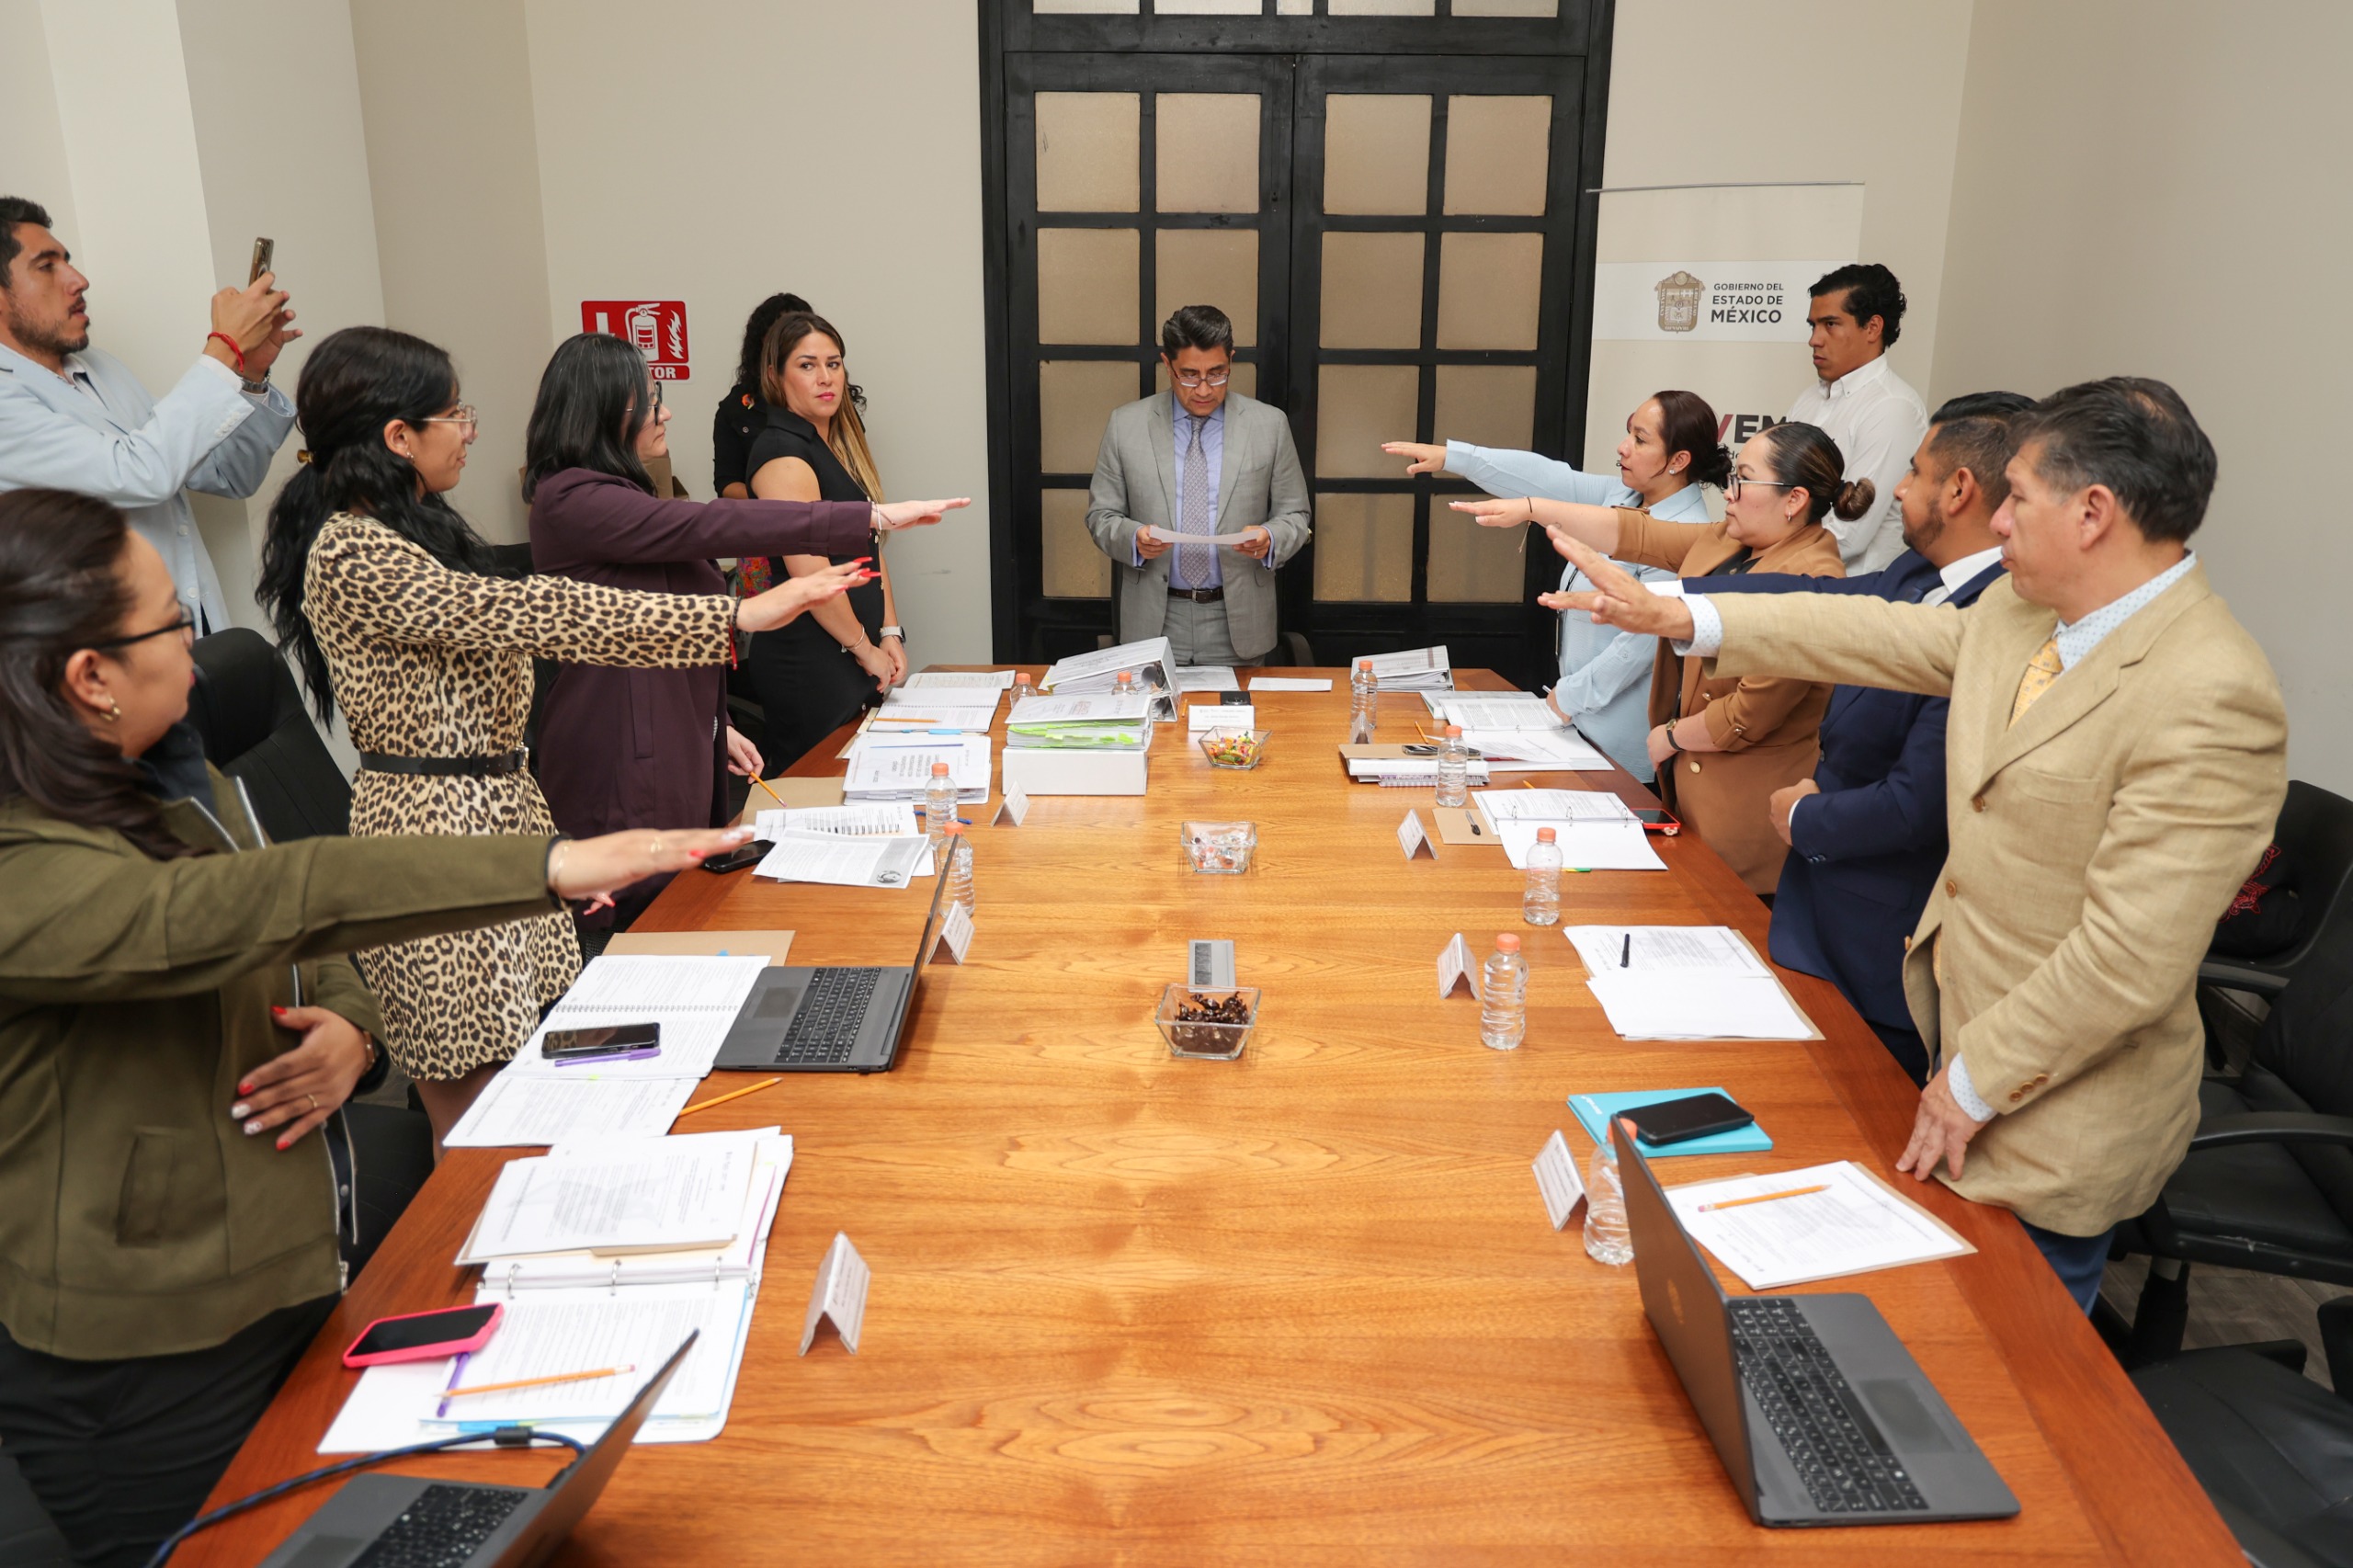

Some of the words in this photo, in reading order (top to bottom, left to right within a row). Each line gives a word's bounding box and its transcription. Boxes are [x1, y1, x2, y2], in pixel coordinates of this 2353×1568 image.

[1712, 295, 1764, 305] ESTADO
[1767, 295, 1783, 305] DE
[1711, 305, 1782, 324] MÉXICO
